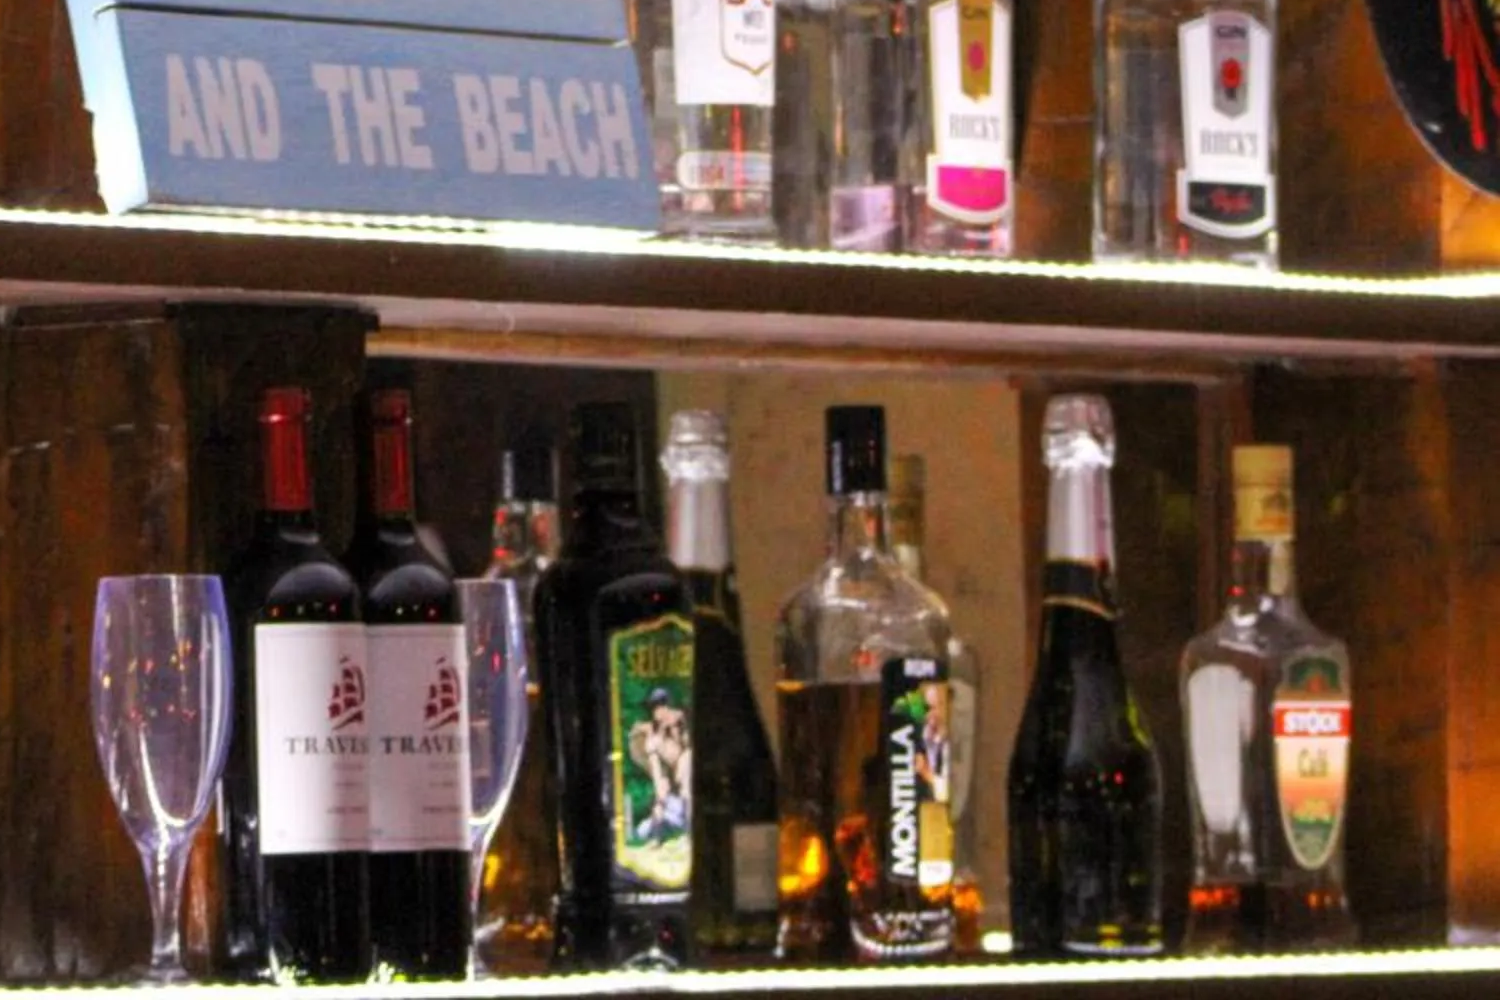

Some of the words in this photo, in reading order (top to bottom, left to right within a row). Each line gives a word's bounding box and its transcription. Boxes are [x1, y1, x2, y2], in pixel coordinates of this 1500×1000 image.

[165, 53, 282, 162] AND
[310, 62, 434, 169] THE
[452, 72, 640, 179] BEACH
[890, 724, 918, 878] MONTILLA
